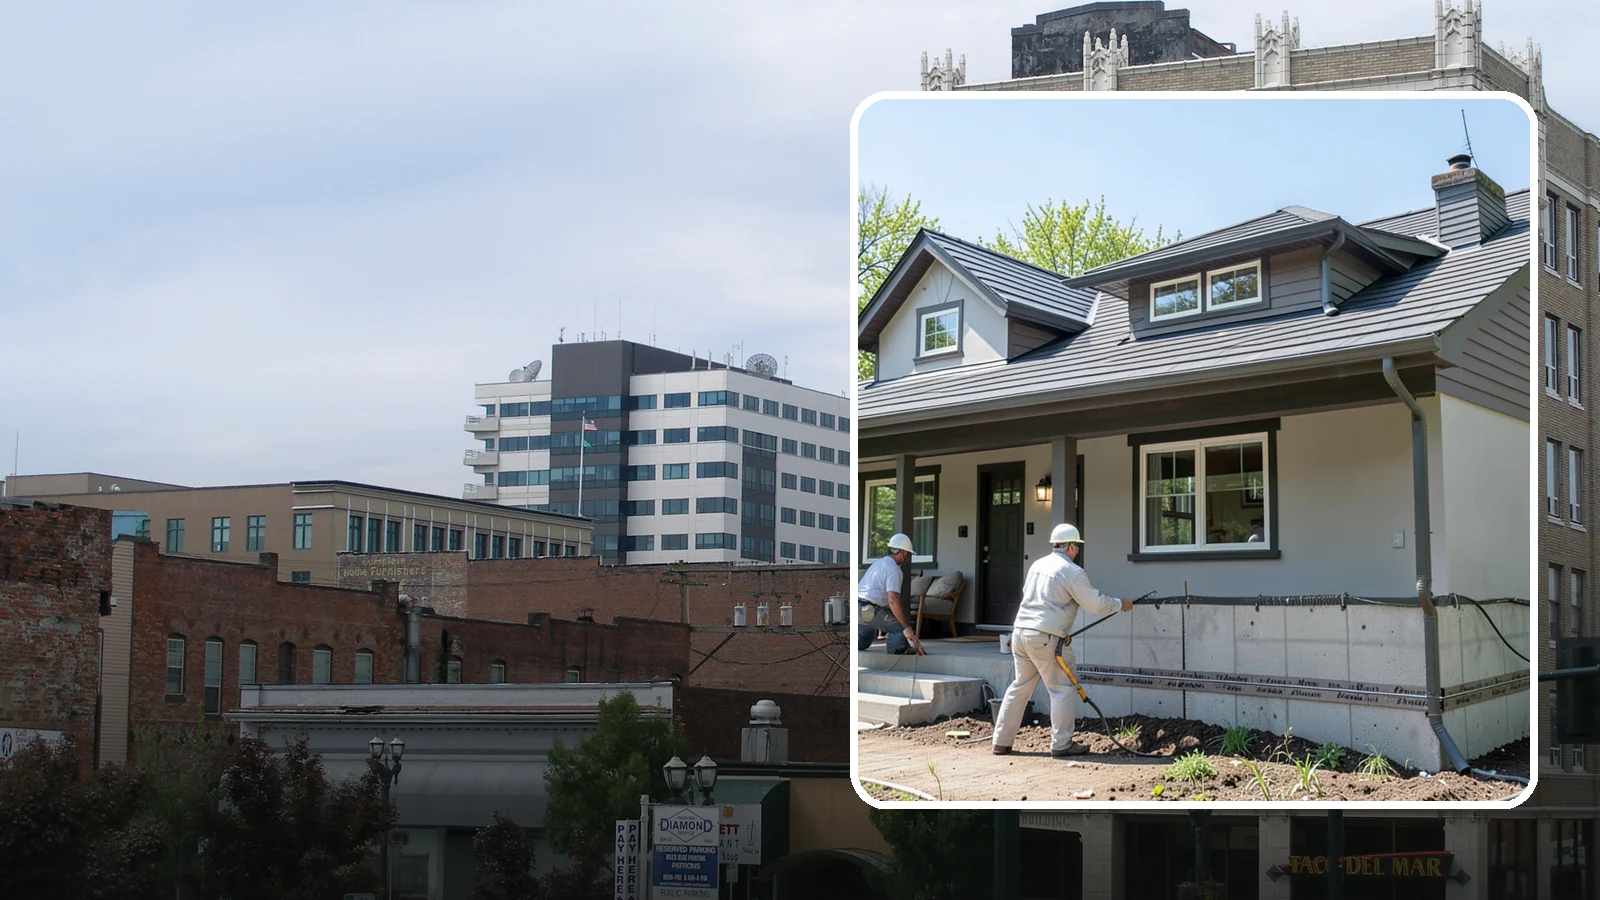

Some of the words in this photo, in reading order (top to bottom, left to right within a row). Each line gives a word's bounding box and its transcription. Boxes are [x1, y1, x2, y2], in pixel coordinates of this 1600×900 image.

[343, 567, 368, 577] Home
[370, 566, 427, 577] Furnishers
[660, 818, 713, 833] DIAMOND
[1022, 815, 1069, 827] BUILDING
[617, 825, 625, 852] PAY
[628, 825, 637, 852] PAY
[656, 845, 688, 853] RESERVED
[689, 846, 716, 854] PARKING
[721, 852, 739, 862] Soup
[1288, 854, 1331, 875] TAC
[1346, 856, 1384, 876] DEL
[1392, 857, 1442, 877] MAR
[616, 856, 625, 893] HERE
[627, 855, 636, 893] HERE
[660, 888, 682, 897] PUBLIC
[683, 889, 710, 898] PARKING
